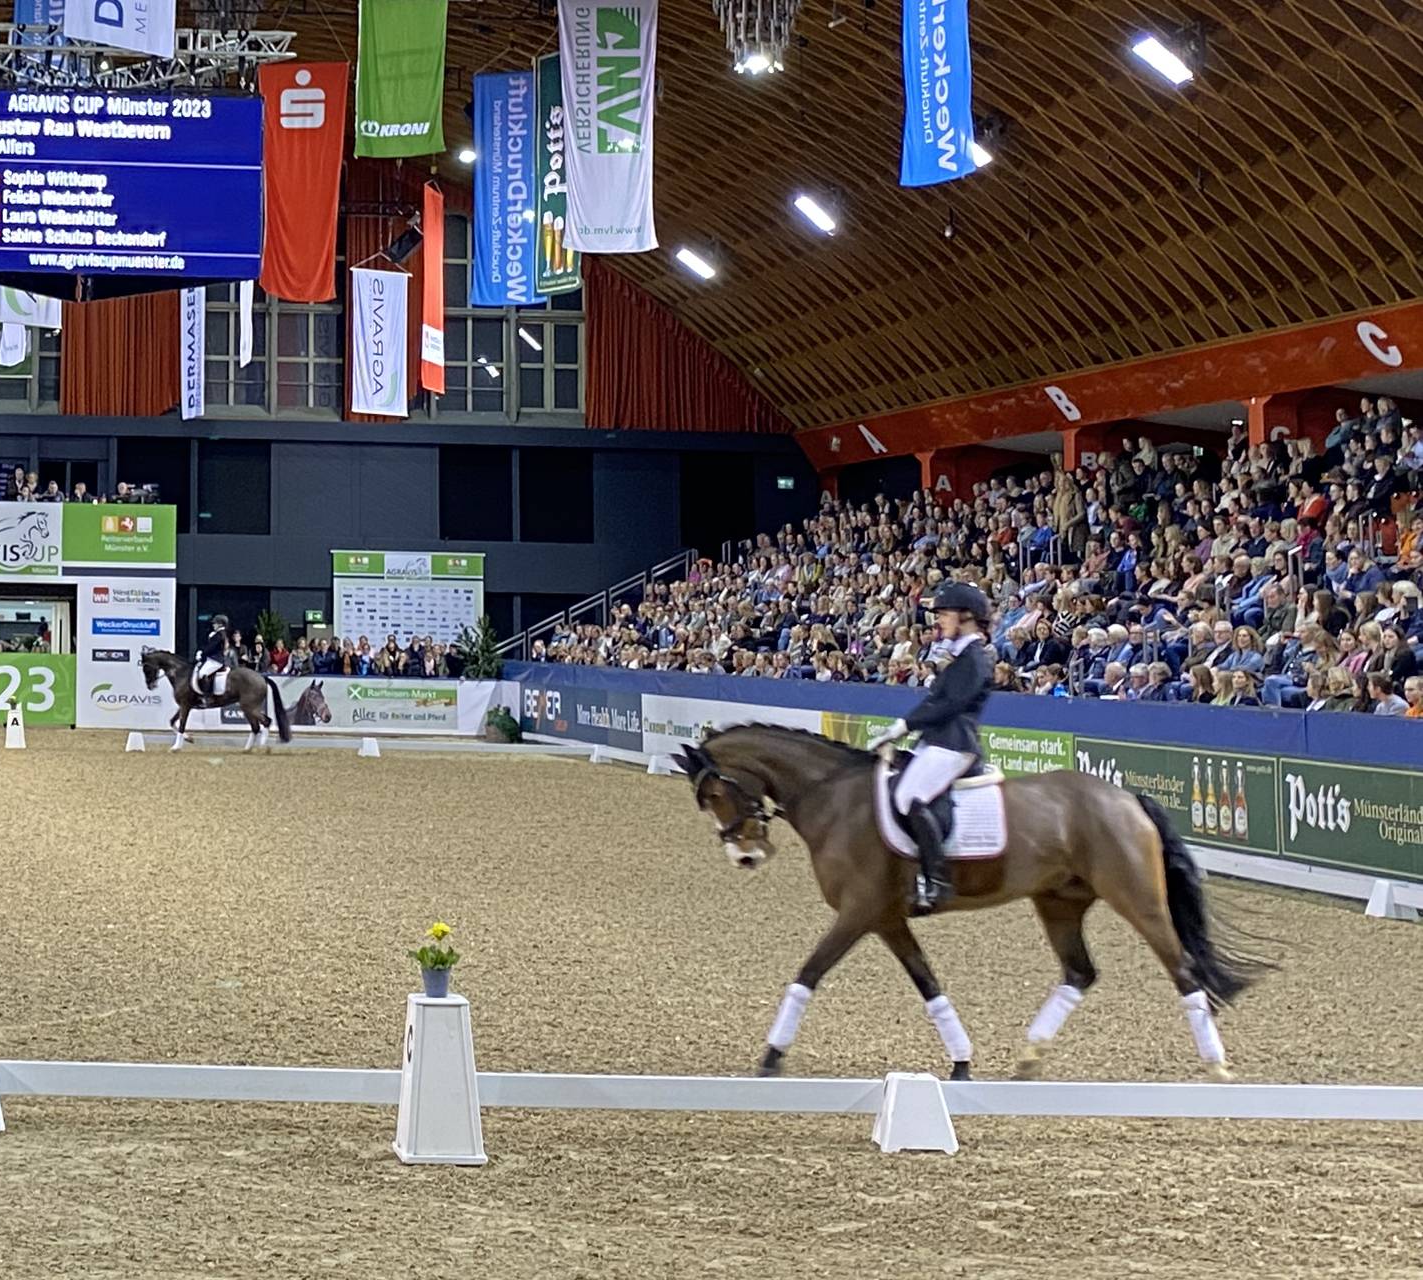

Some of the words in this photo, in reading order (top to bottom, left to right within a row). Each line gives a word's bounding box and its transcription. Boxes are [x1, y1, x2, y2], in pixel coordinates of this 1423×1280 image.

[8, 94, 71, 114] AGRAVIS
[73, 95, 105, 115] CUP
[107, 97, 169, 117] Münster
[172, 98, 212, 119] 2023
[43, 118, 75, 137] Rau
[77, 119, 172, 140] Westbevern
[3, 169, 45, 189] Sophia
[2, 189, 41, 205] Felicia
[2, 208, 37, 224] Laura
[2, 227, 43, 244] Sabine
[44, 228, 94, 245] Schulze
[29, 252, 185, 270] www.agraviscupmuenster.de
[1356, 321, 1403, 368] C
[1044, 385, 1081, 421] B
[858, 424, 888, 454] A
[96, 694, 162, 704] AGRAVIS
[10, 717, 20, 727] A
[989, 732, 1039, 753] Gemeinsam
[1040, 737, 1066, 756] stark.
[1002, 755, 1023, 771] Land
[1125, 769, 1186, 796] Münsterländer
[1285, 773, 1352, 842] Pott's
